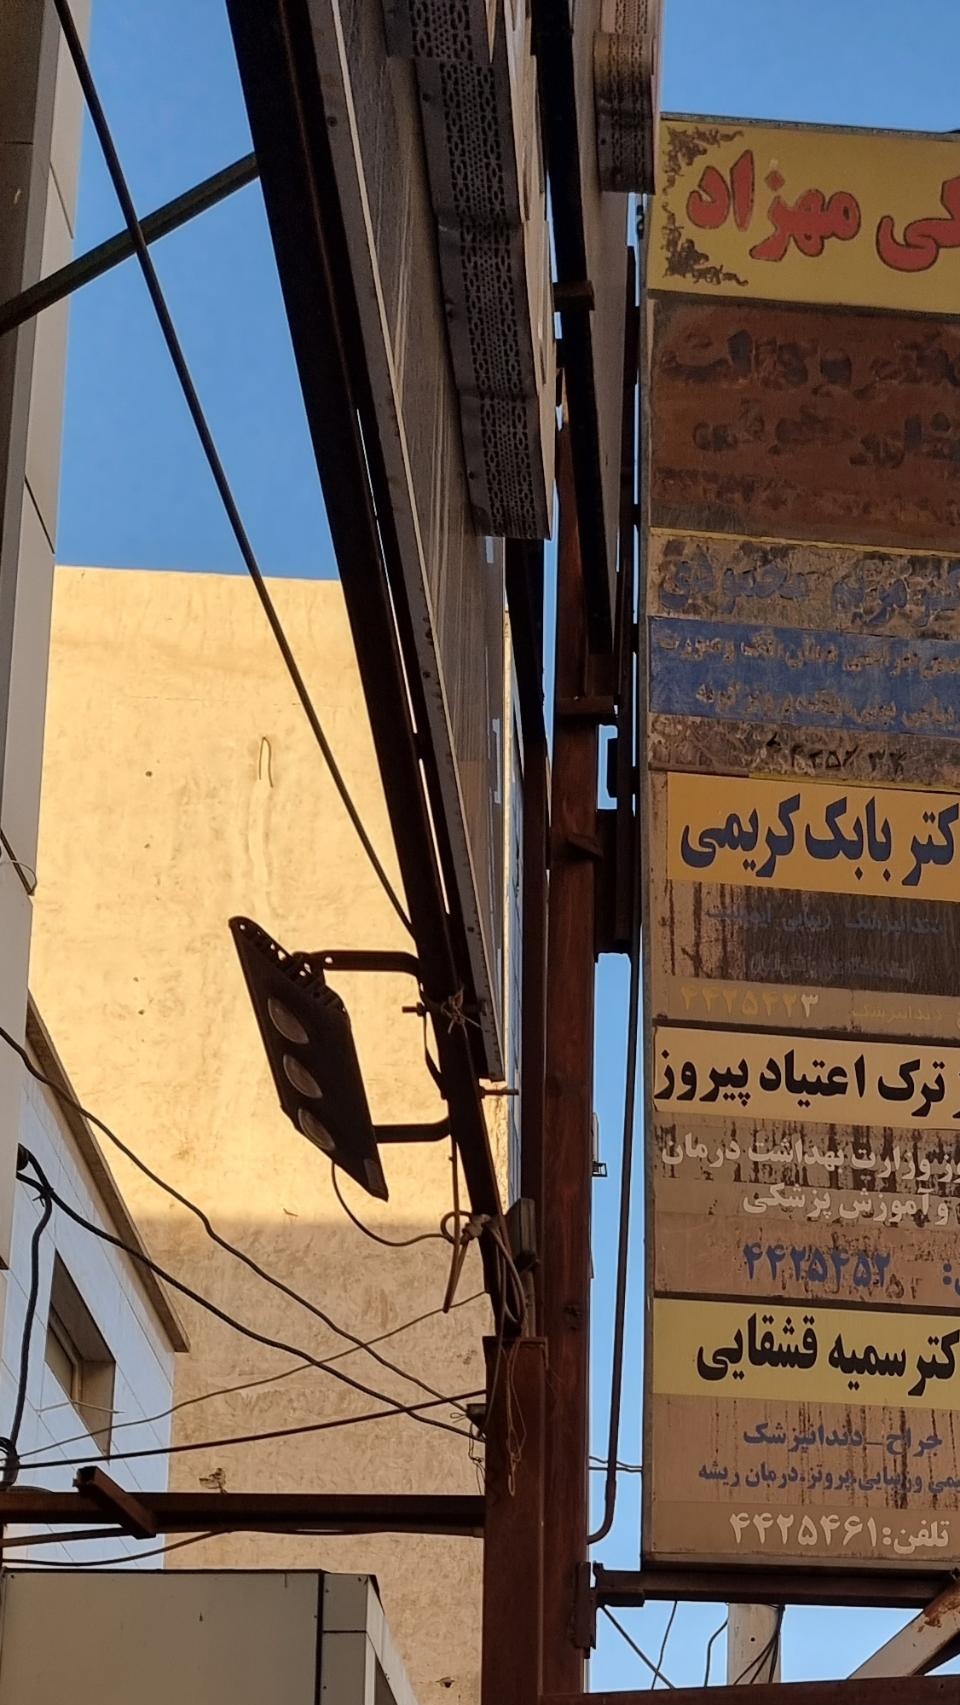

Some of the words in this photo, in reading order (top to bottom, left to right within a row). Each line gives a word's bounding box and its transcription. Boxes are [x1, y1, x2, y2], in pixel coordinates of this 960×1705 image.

[681, 792, 800, 878] کریمی
[804, 796, 892, 882] بابک
[654, 1048, 751, 1107] پیروز
[759, 1048, 866, 1109] اعتیاد
[877, 1059, 946, 1117] ترک
[660, 1132, 741, 1168] درمان
[747, 1136, 846, 1174] بهداشت
[742, 1181, 832, 1220] پزشکی
[838, 1186, 937, 1222] آموزش
[696, 1312, 819, 1382] قشقایی
[827, 1332, 907, 1391] سمیه
[742, 1422, 865, 1455] دندانپزشک
[885, 1427, 944, 1458] جراح
[698, 1460, 741, 1487] ریشه
[729, 1511, 878, 1547] ۴۴۲۵۴۶۱
